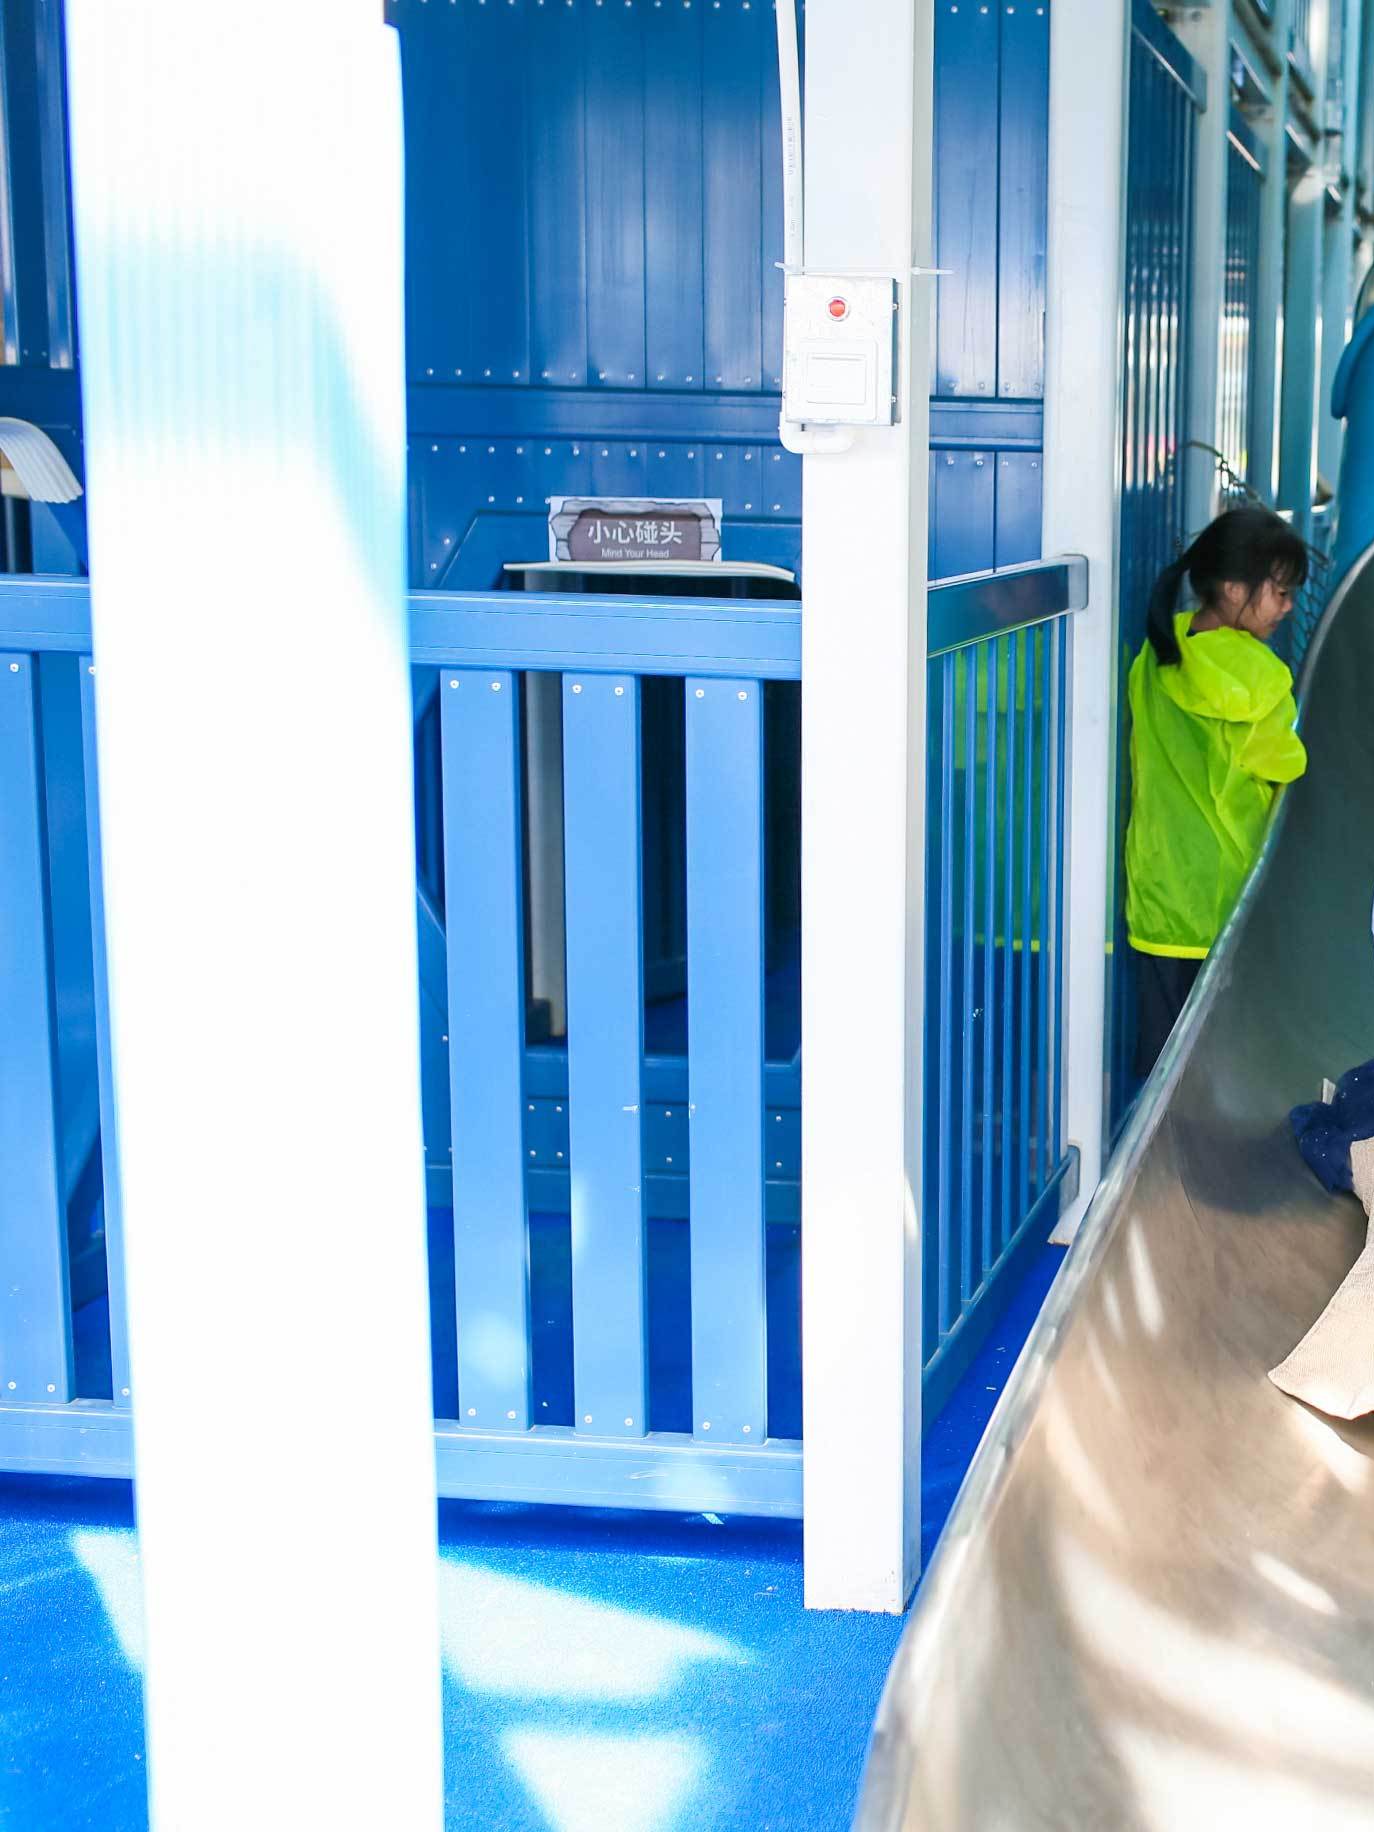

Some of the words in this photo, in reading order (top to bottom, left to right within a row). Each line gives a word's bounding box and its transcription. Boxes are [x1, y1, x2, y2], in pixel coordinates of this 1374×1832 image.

[588, 520, 682, 544] 小心碰头
[601, 548, 622, 558] Mind
[625, 548, 644, 558] Your
[646, 549, 669, 558] Head
